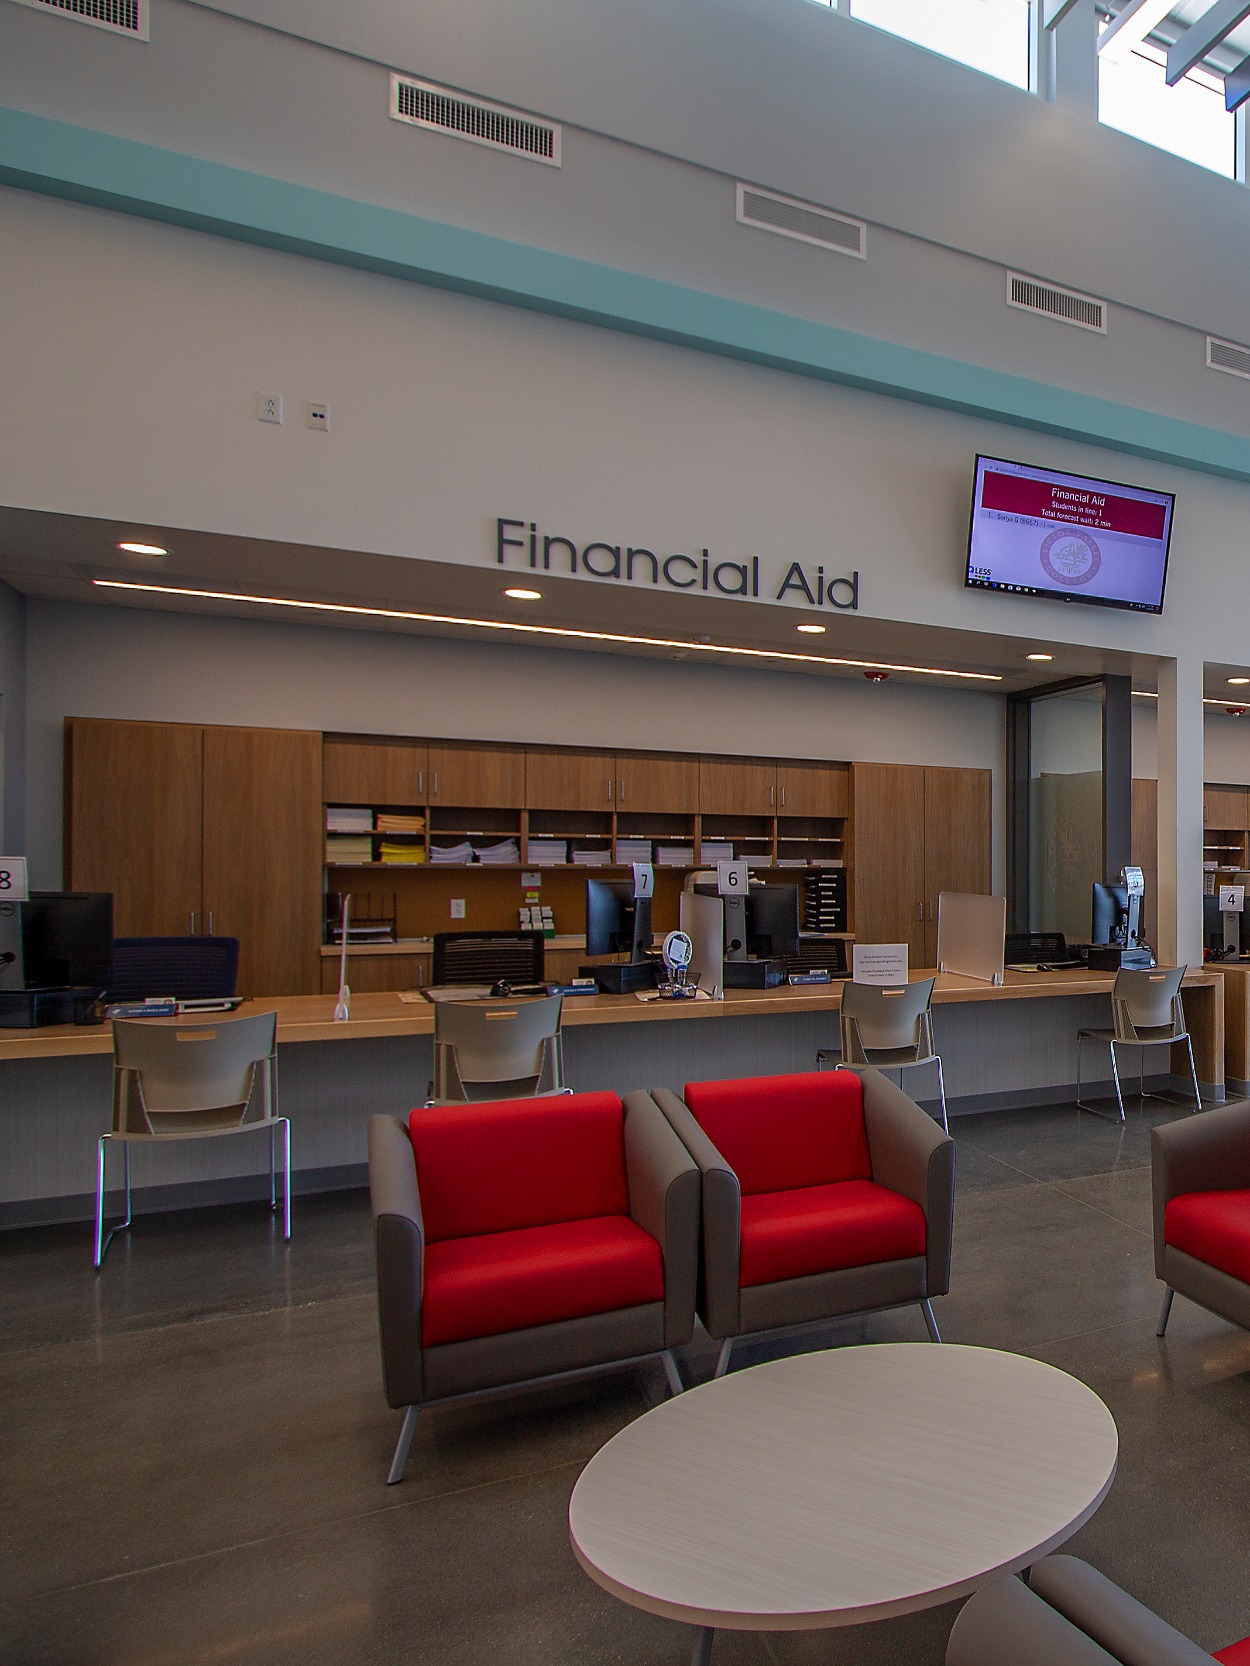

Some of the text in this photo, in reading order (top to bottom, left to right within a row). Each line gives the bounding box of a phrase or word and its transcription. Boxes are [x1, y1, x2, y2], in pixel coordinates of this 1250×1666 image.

[1051, 487, 1106, 506] Financial Aid
[1051, 501, 1077, 511] Students
[1041, 509, 1056, 518] Total
[1057, 511, 1079, 522] forecast
[1100, 520, 1111, 528] min
[497, 518, 859, 610] Financial Aid
[0, 870, 12, 890] 8
[641, 874, 648, 889] 7
[728, 871, 738, 886] 6
[1227, 894, 1236, 906] 4
